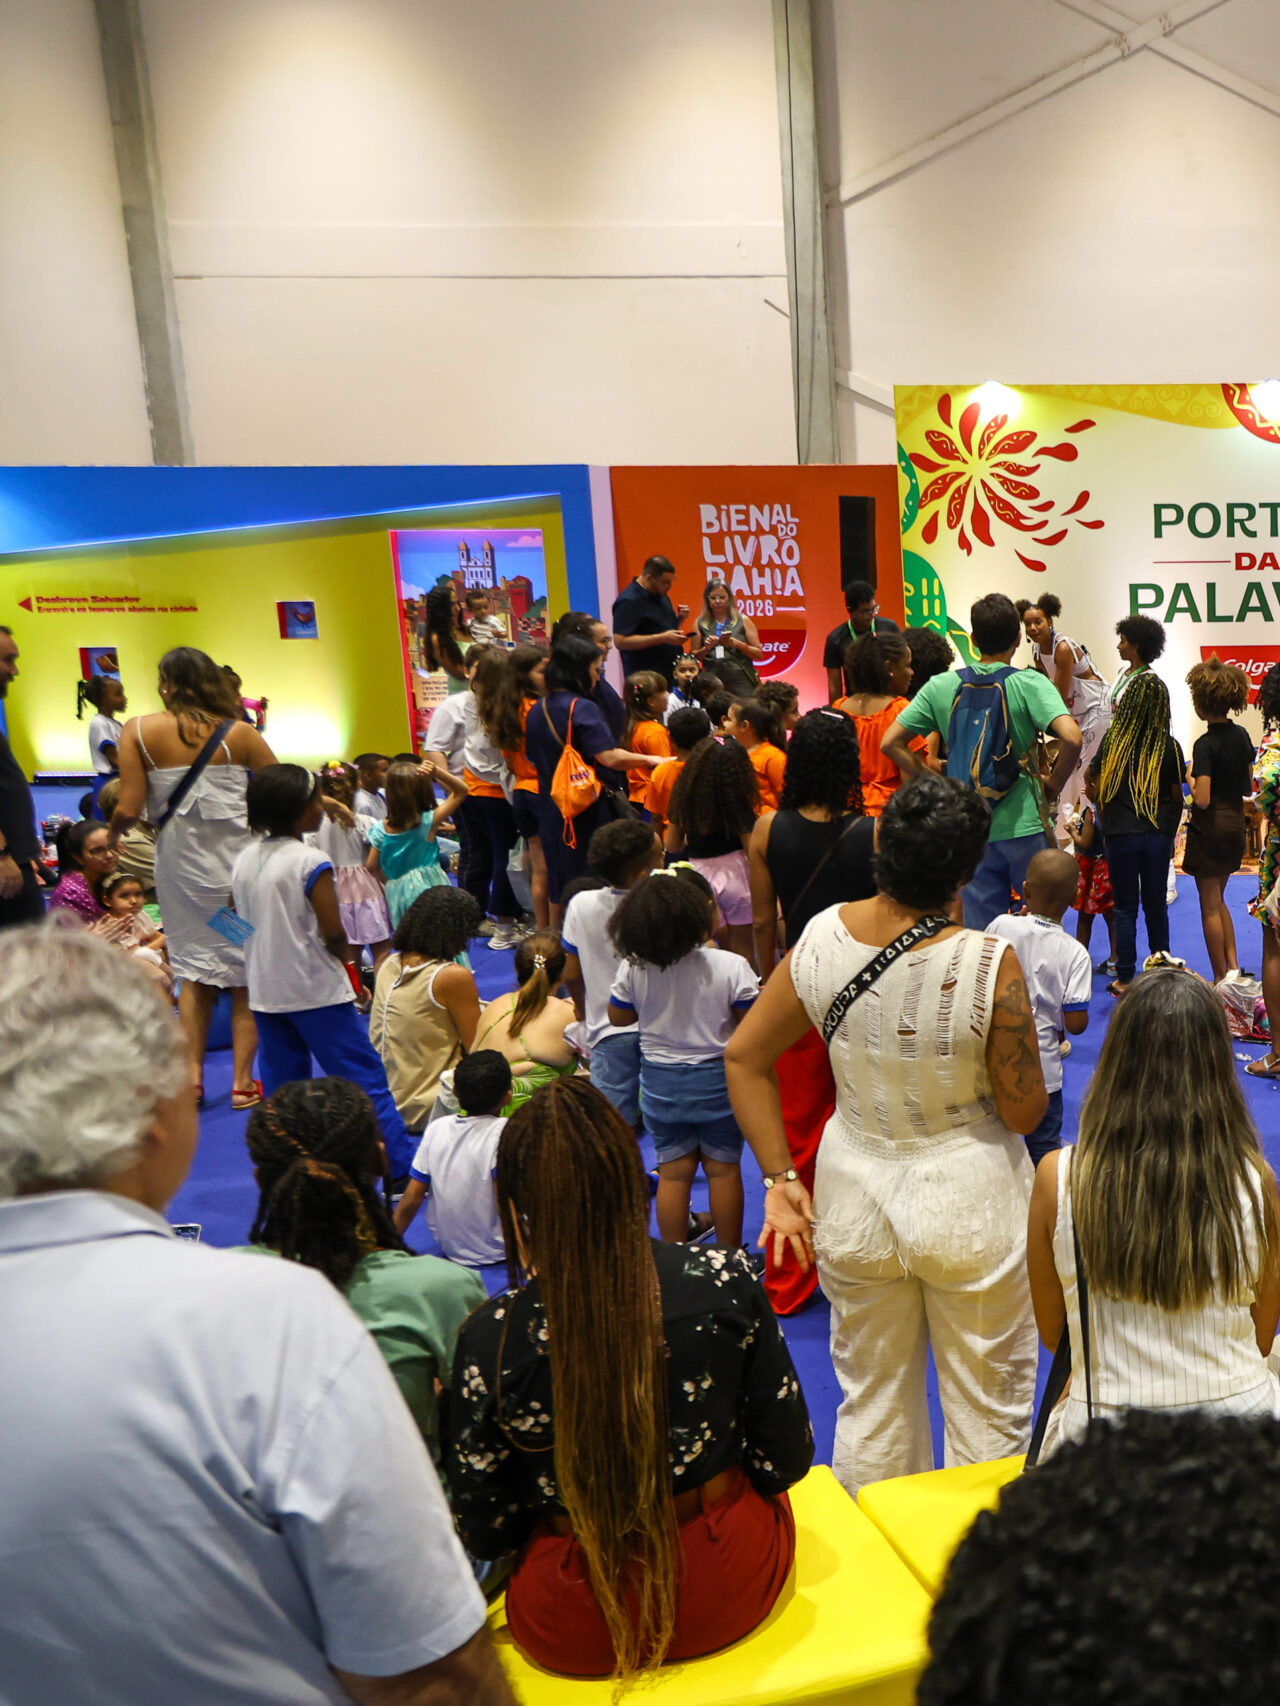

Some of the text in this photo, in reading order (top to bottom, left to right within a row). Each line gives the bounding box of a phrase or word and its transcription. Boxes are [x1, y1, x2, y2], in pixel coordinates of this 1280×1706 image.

[777, 523, 797, 539] DO
[702, 534, 801, 567] LIVRO
[1234, 552, 1280, 571] DA
[736, 599, 774, 616] 2026
